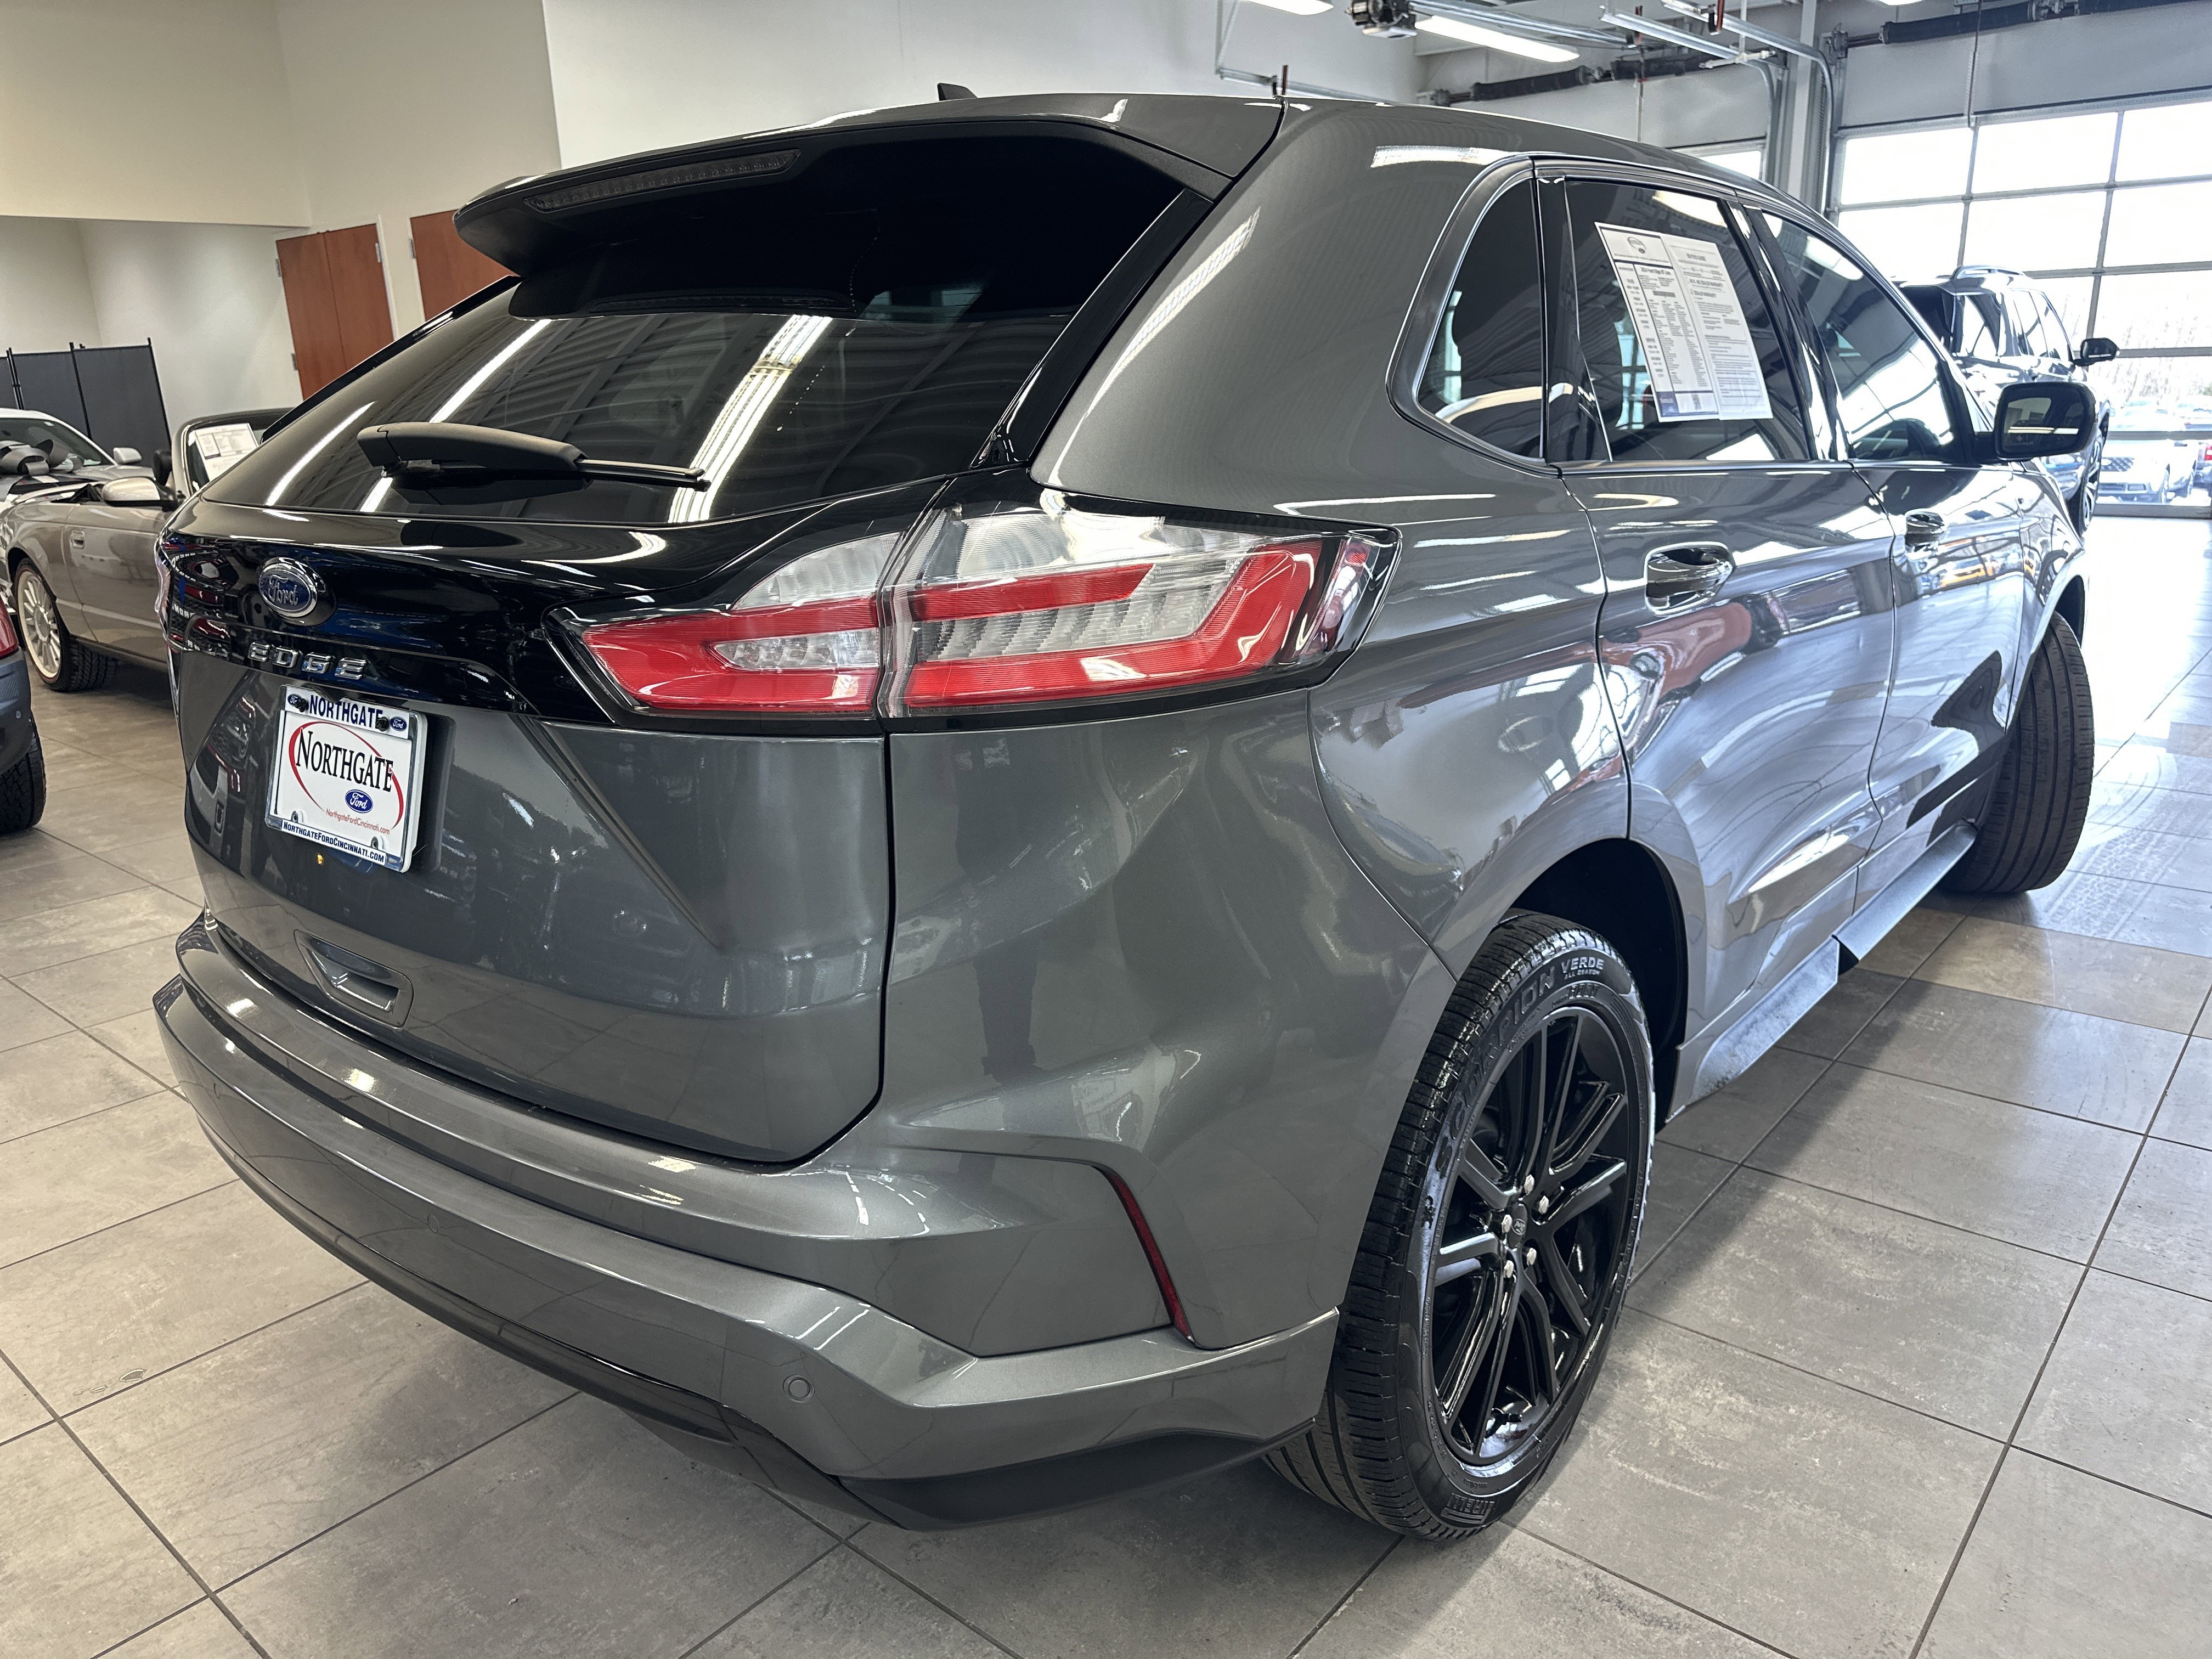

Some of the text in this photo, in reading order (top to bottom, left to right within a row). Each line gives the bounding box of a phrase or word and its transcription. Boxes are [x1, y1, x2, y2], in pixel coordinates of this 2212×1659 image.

[268, 574, 299, 606] Ford
[249, 642, 367, 680] EDGE
[392, 719, 404, 729] Ford
[296, 729, 394, 792] NORTHGATE
[350, 791, 369, 810] Ford
[283, 821, 385, 863] NORTHGATEFORDCINCINNATI.COM
[1561, 956, 1605, 974] VERDE
[1564, 968, 1601, 980] ALL SEASON
